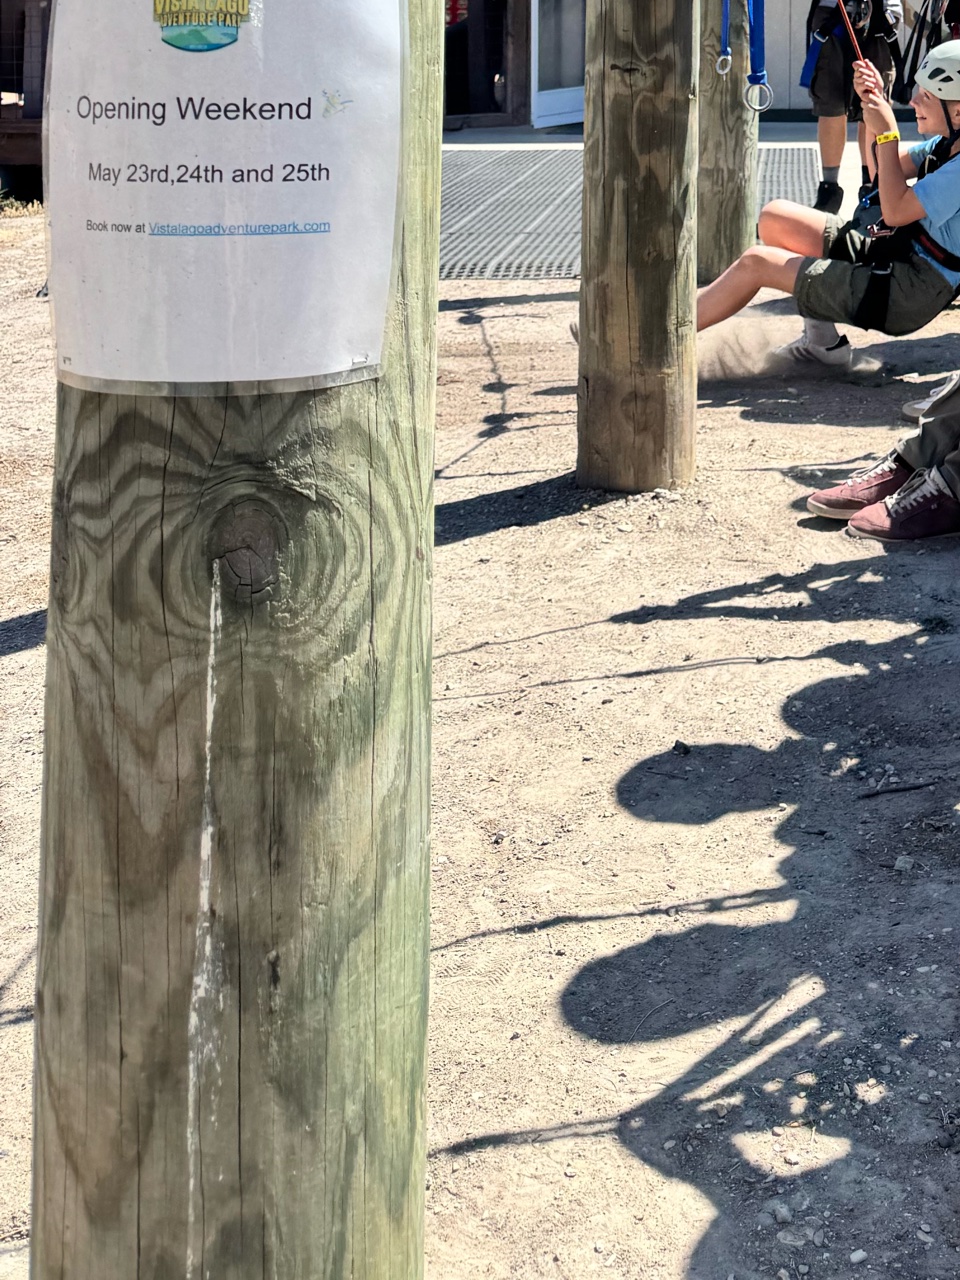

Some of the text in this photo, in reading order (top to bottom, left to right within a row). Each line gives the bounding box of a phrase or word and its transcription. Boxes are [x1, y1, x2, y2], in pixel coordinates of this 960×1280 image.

[76, 95, 312, 126] Opening Weekend
[89, 163, 330, 186] May 23rd,24th and 25th
[86, 219, 330, 236] Book now at Vistalagoadventurepark.com
